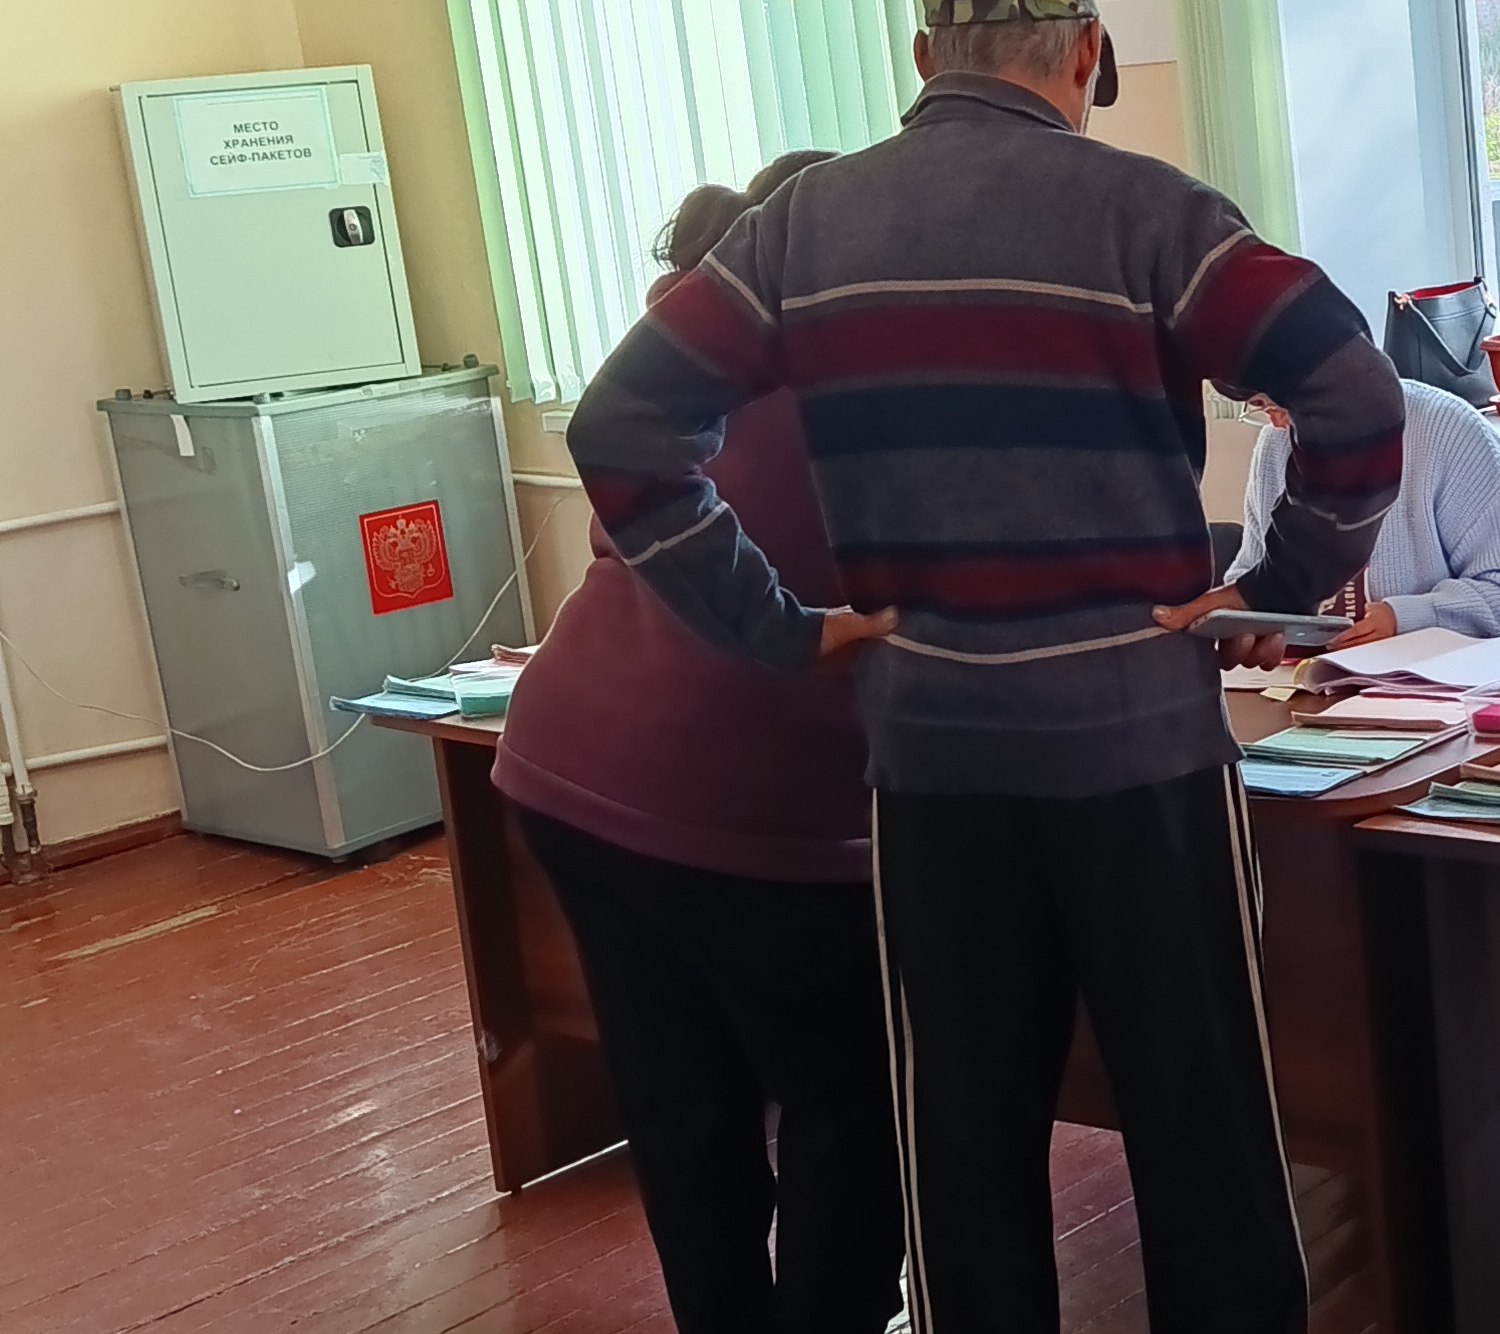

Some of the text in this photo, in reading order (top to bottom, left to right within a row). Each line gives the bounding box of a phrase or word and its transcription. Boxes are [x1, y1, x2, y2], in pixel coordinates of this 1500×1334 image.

[233, 120, 279, 134] МЕСТО
[223, 134, 294, 150] ХРАНЕНИЯ
[209, 148, 312, 166] СЕЙФ-ПАКЕТОВ
